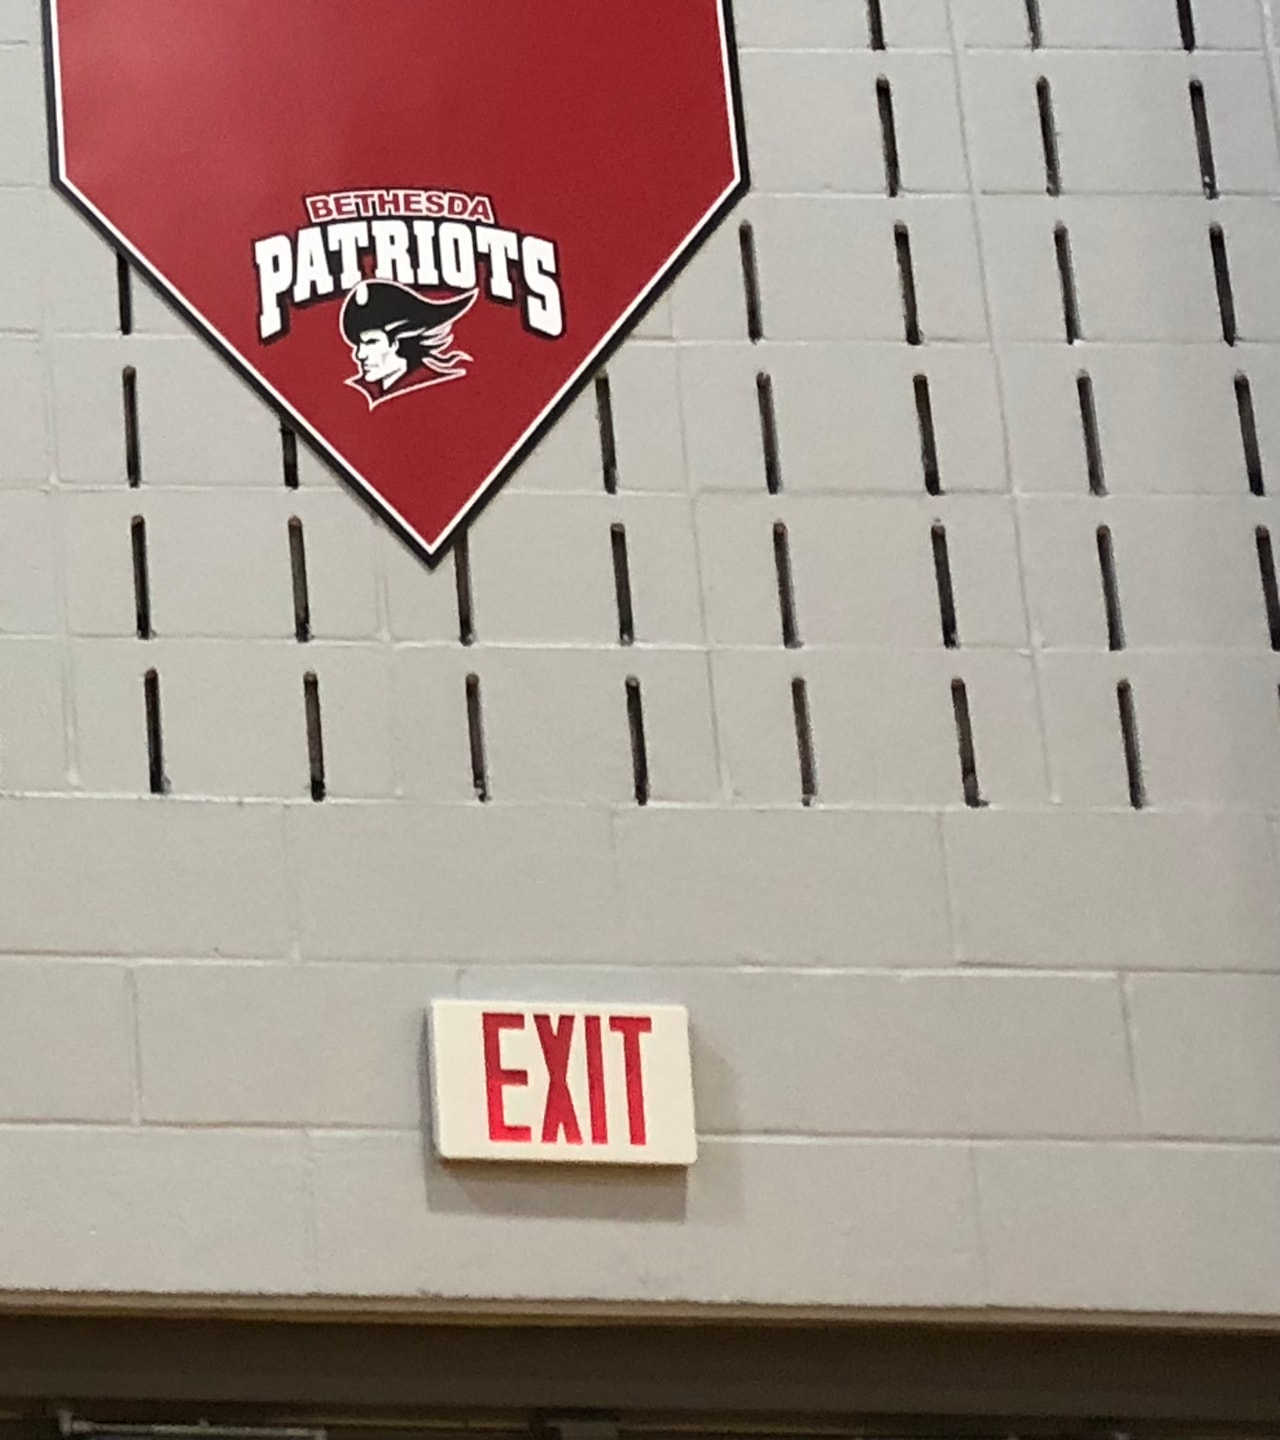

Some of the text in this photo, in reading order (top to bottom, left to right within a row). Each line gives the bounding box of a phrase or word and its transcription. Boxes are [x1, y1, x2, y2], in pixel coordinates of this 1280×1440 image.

[305, 190, 494, 223] BETHESDA
[255, 220, 563, 338] PATRIOTS
[483, 1011, 653, 1146] EXIT
